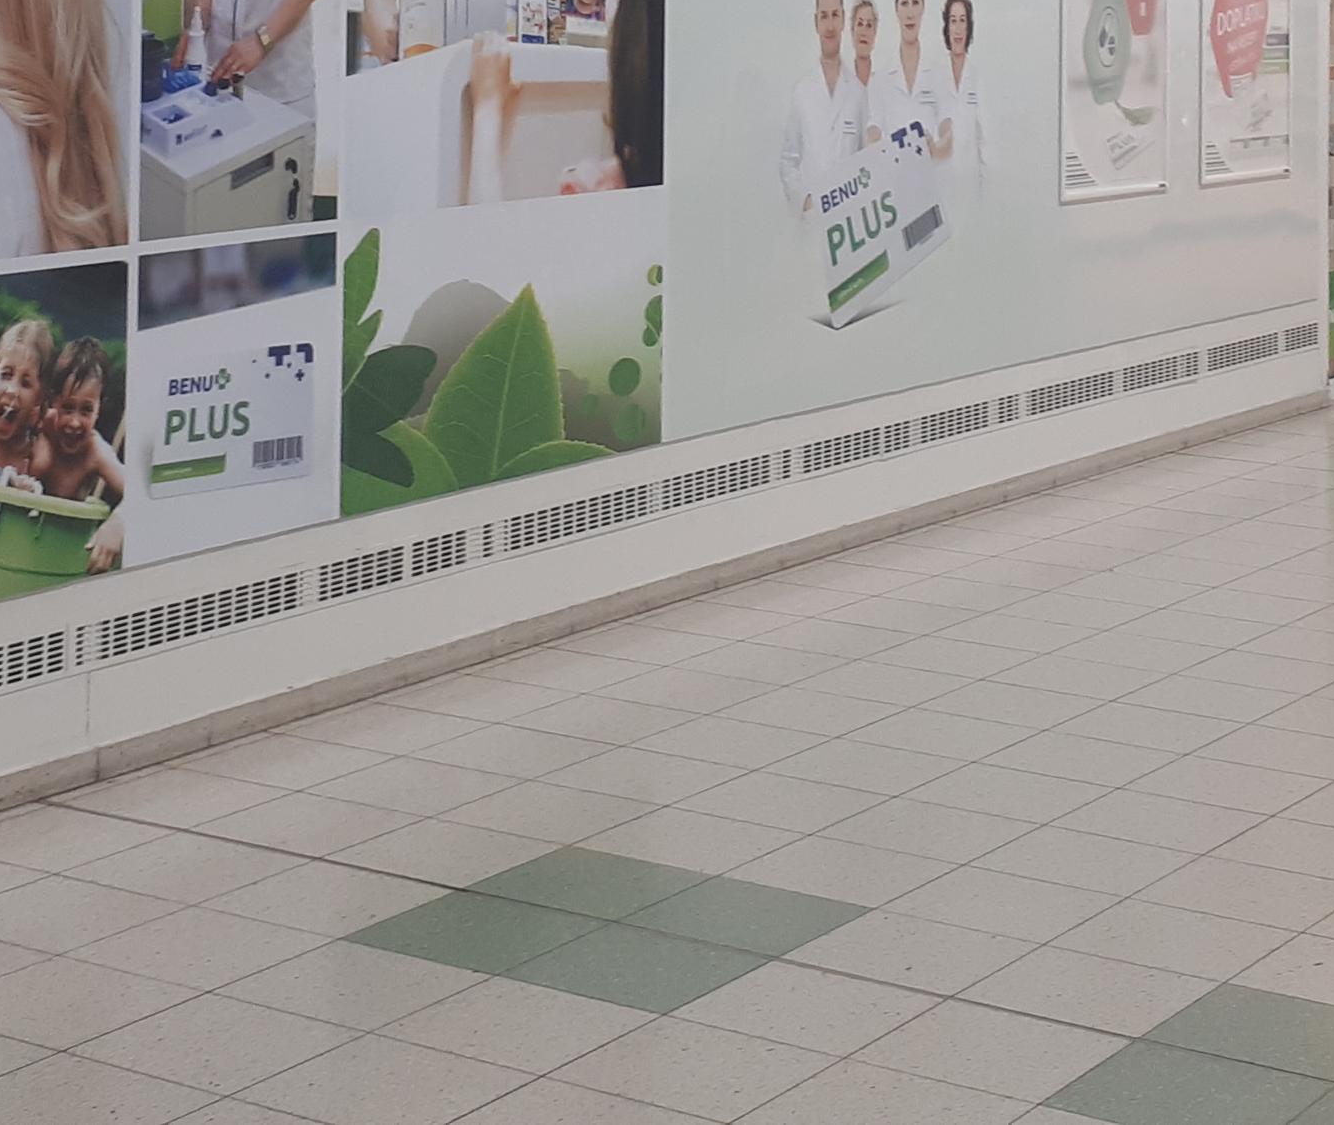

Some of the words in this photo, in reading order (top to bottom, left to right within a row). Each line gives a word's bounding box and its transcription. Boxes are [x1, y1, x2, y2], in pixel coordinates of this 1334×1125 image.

[819, 177, 860, 214] BENU
[826, 189, 898, 268] PLUS
[167, 375, 213, 397] BENU
[163, 400, 251, 446] PLUS
